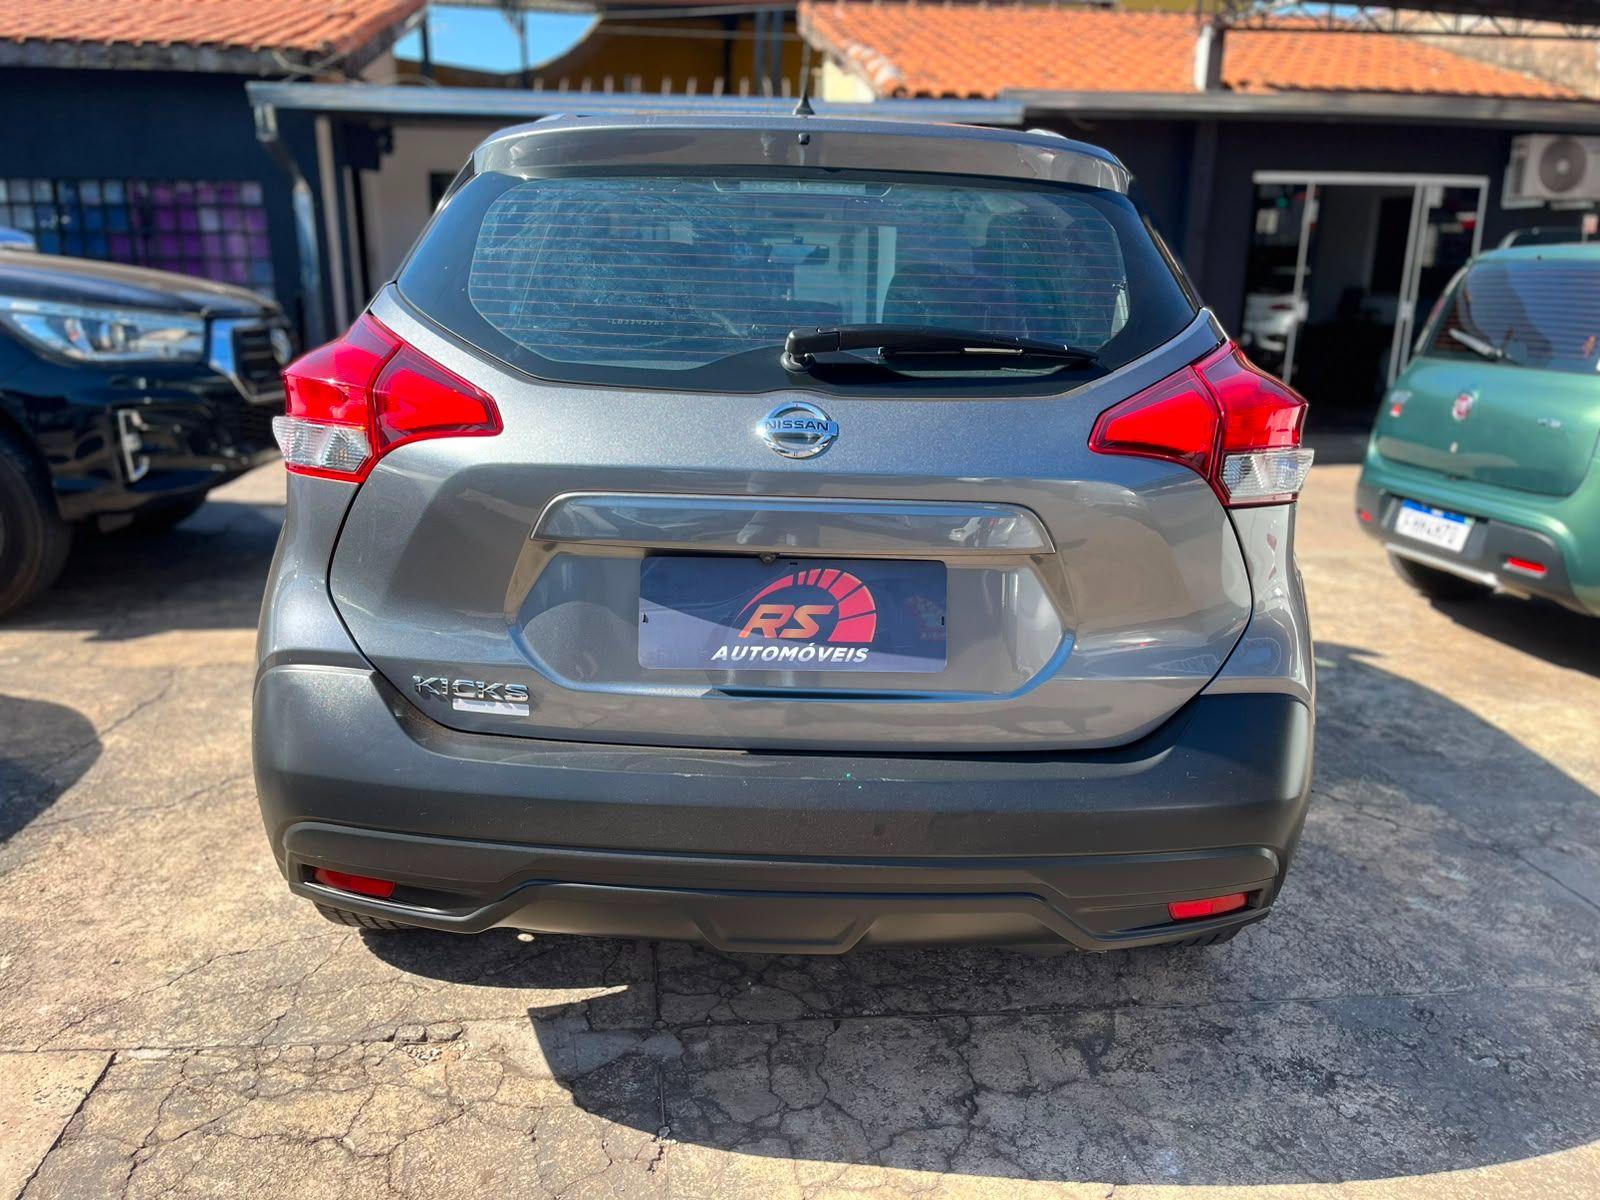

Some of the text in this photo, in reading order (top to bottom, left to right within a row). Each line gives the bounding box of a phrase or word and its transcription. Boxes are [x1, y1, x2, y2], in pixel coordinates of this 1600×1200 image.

[765, 419, 829, 431] NISSAN
[738, 604, 834, 638] RS
[710, 643, 869, 662] AUTOMÓVEIS
[412, 674, 529, 702] KICKS
